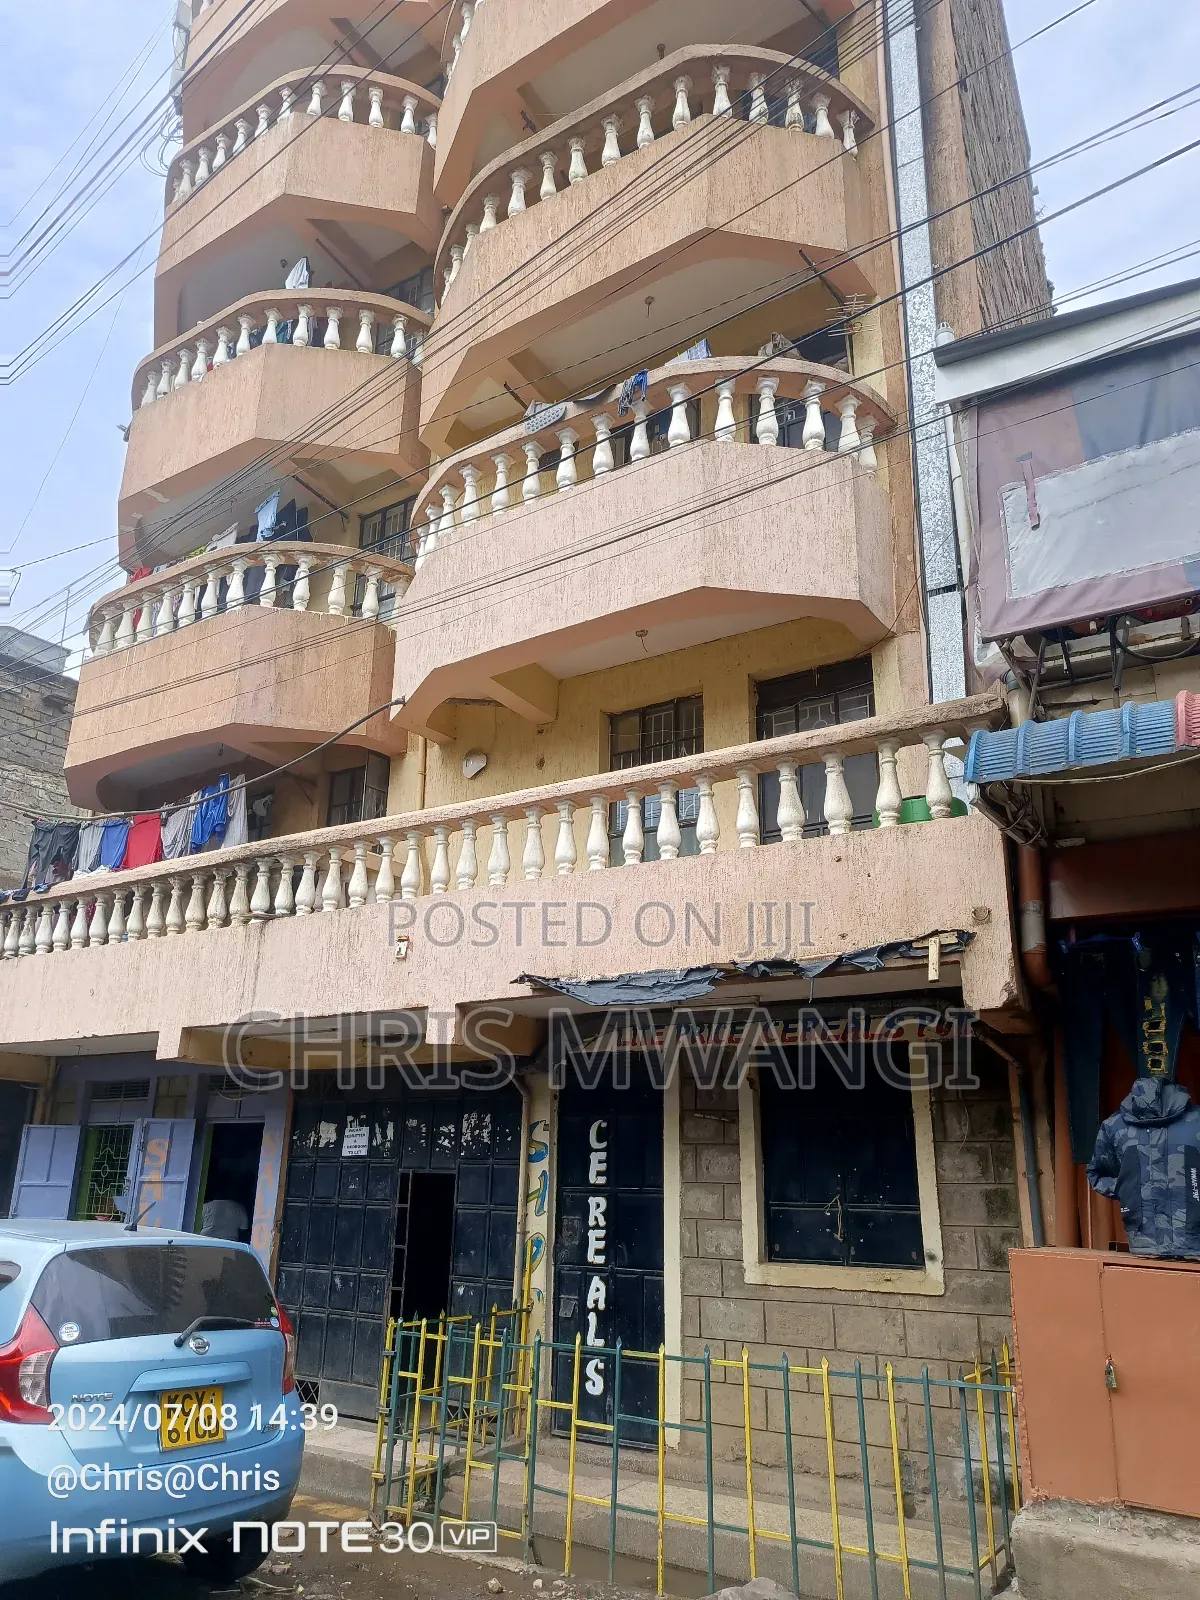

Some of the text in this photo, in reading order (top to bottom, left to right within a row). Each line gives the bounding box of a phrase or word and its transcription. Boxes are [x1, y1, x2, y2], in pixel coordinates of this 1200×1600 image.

[762, 1014, 905, 1043] CEREALS
[585, 1119, 608, 1396] CEREALS
[71, 1392, 114, 1403] NOTE
